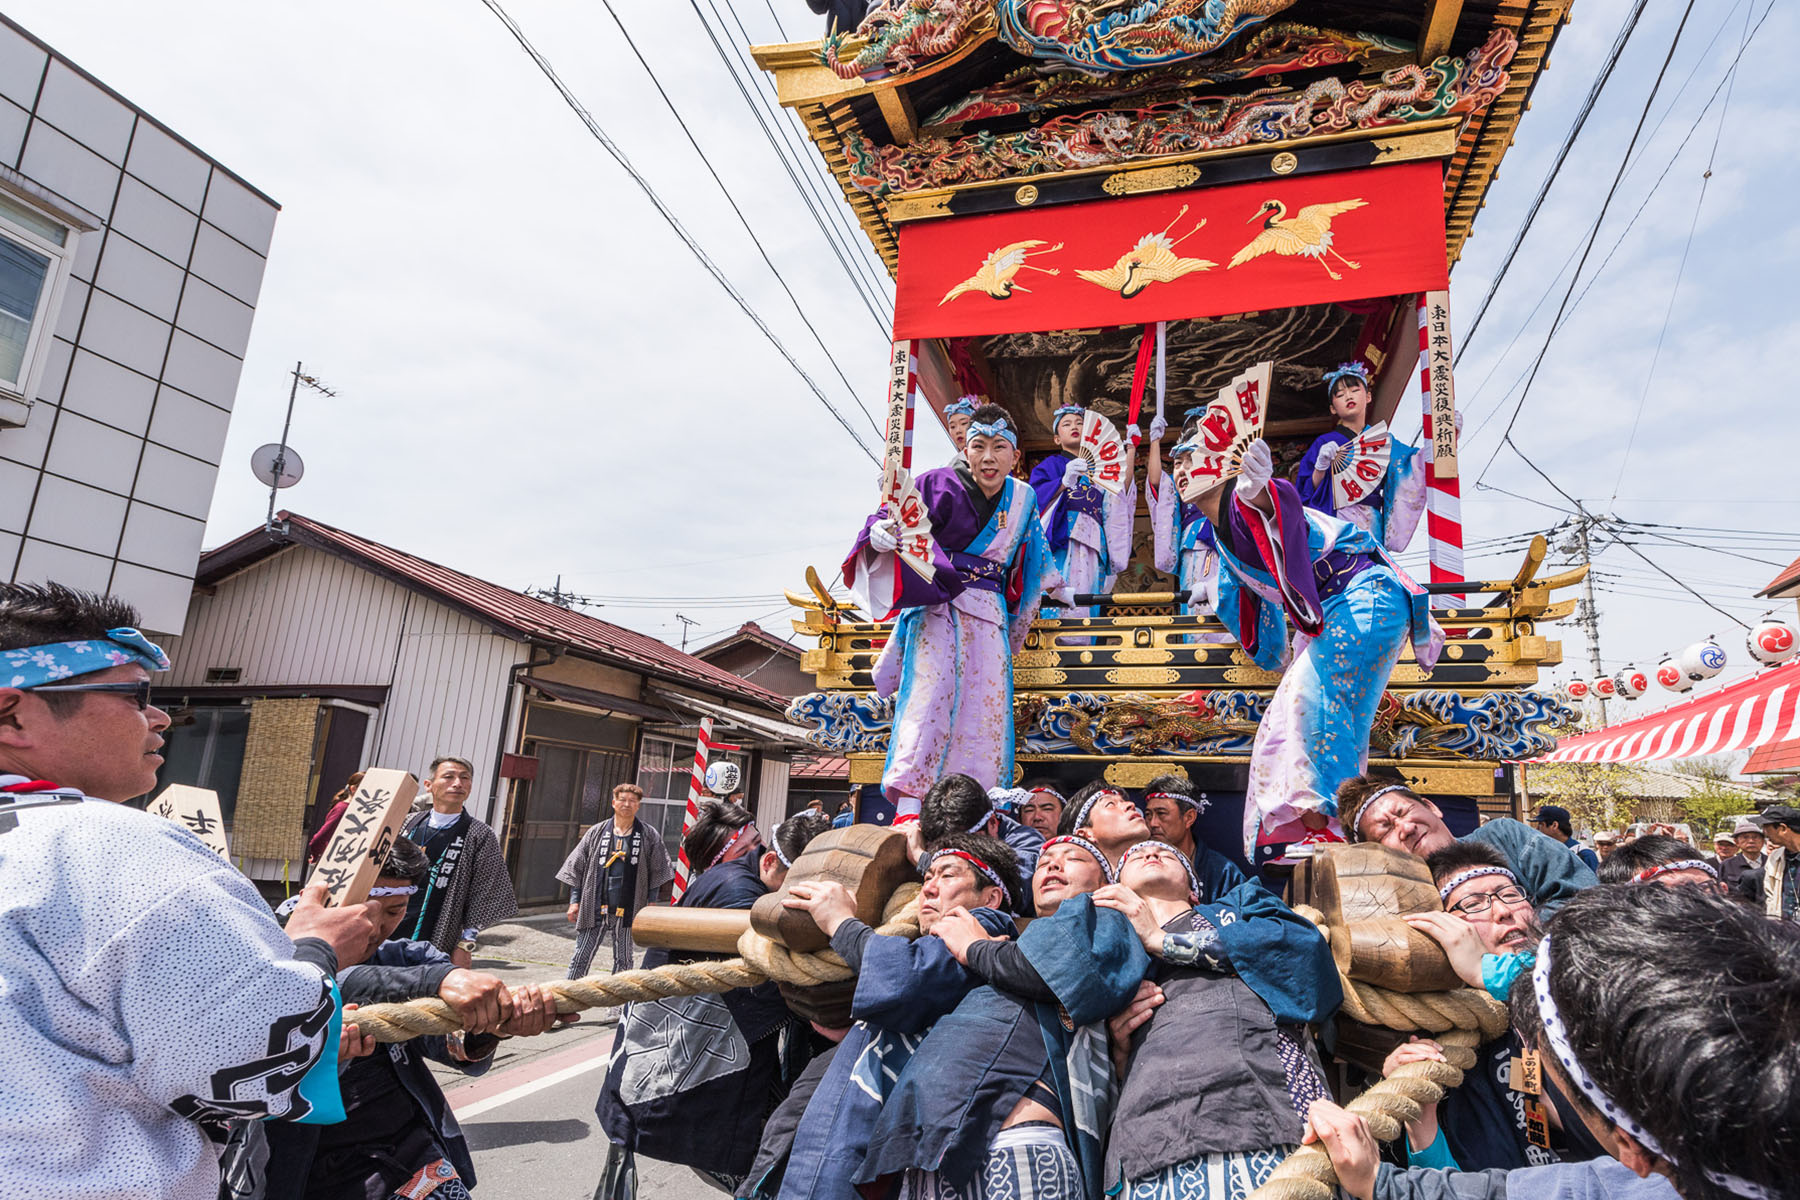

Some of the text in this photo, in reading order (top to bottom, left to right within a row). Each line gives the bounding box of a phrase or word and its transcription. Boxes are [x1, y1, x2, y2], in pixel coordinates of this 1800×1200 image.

[886, 350, 906, 472] 東日本大震災復興
[1431, 304, 1455, 458] 東日本大震災復興祈願
[319, 789, 390, 908] 社例大祭
